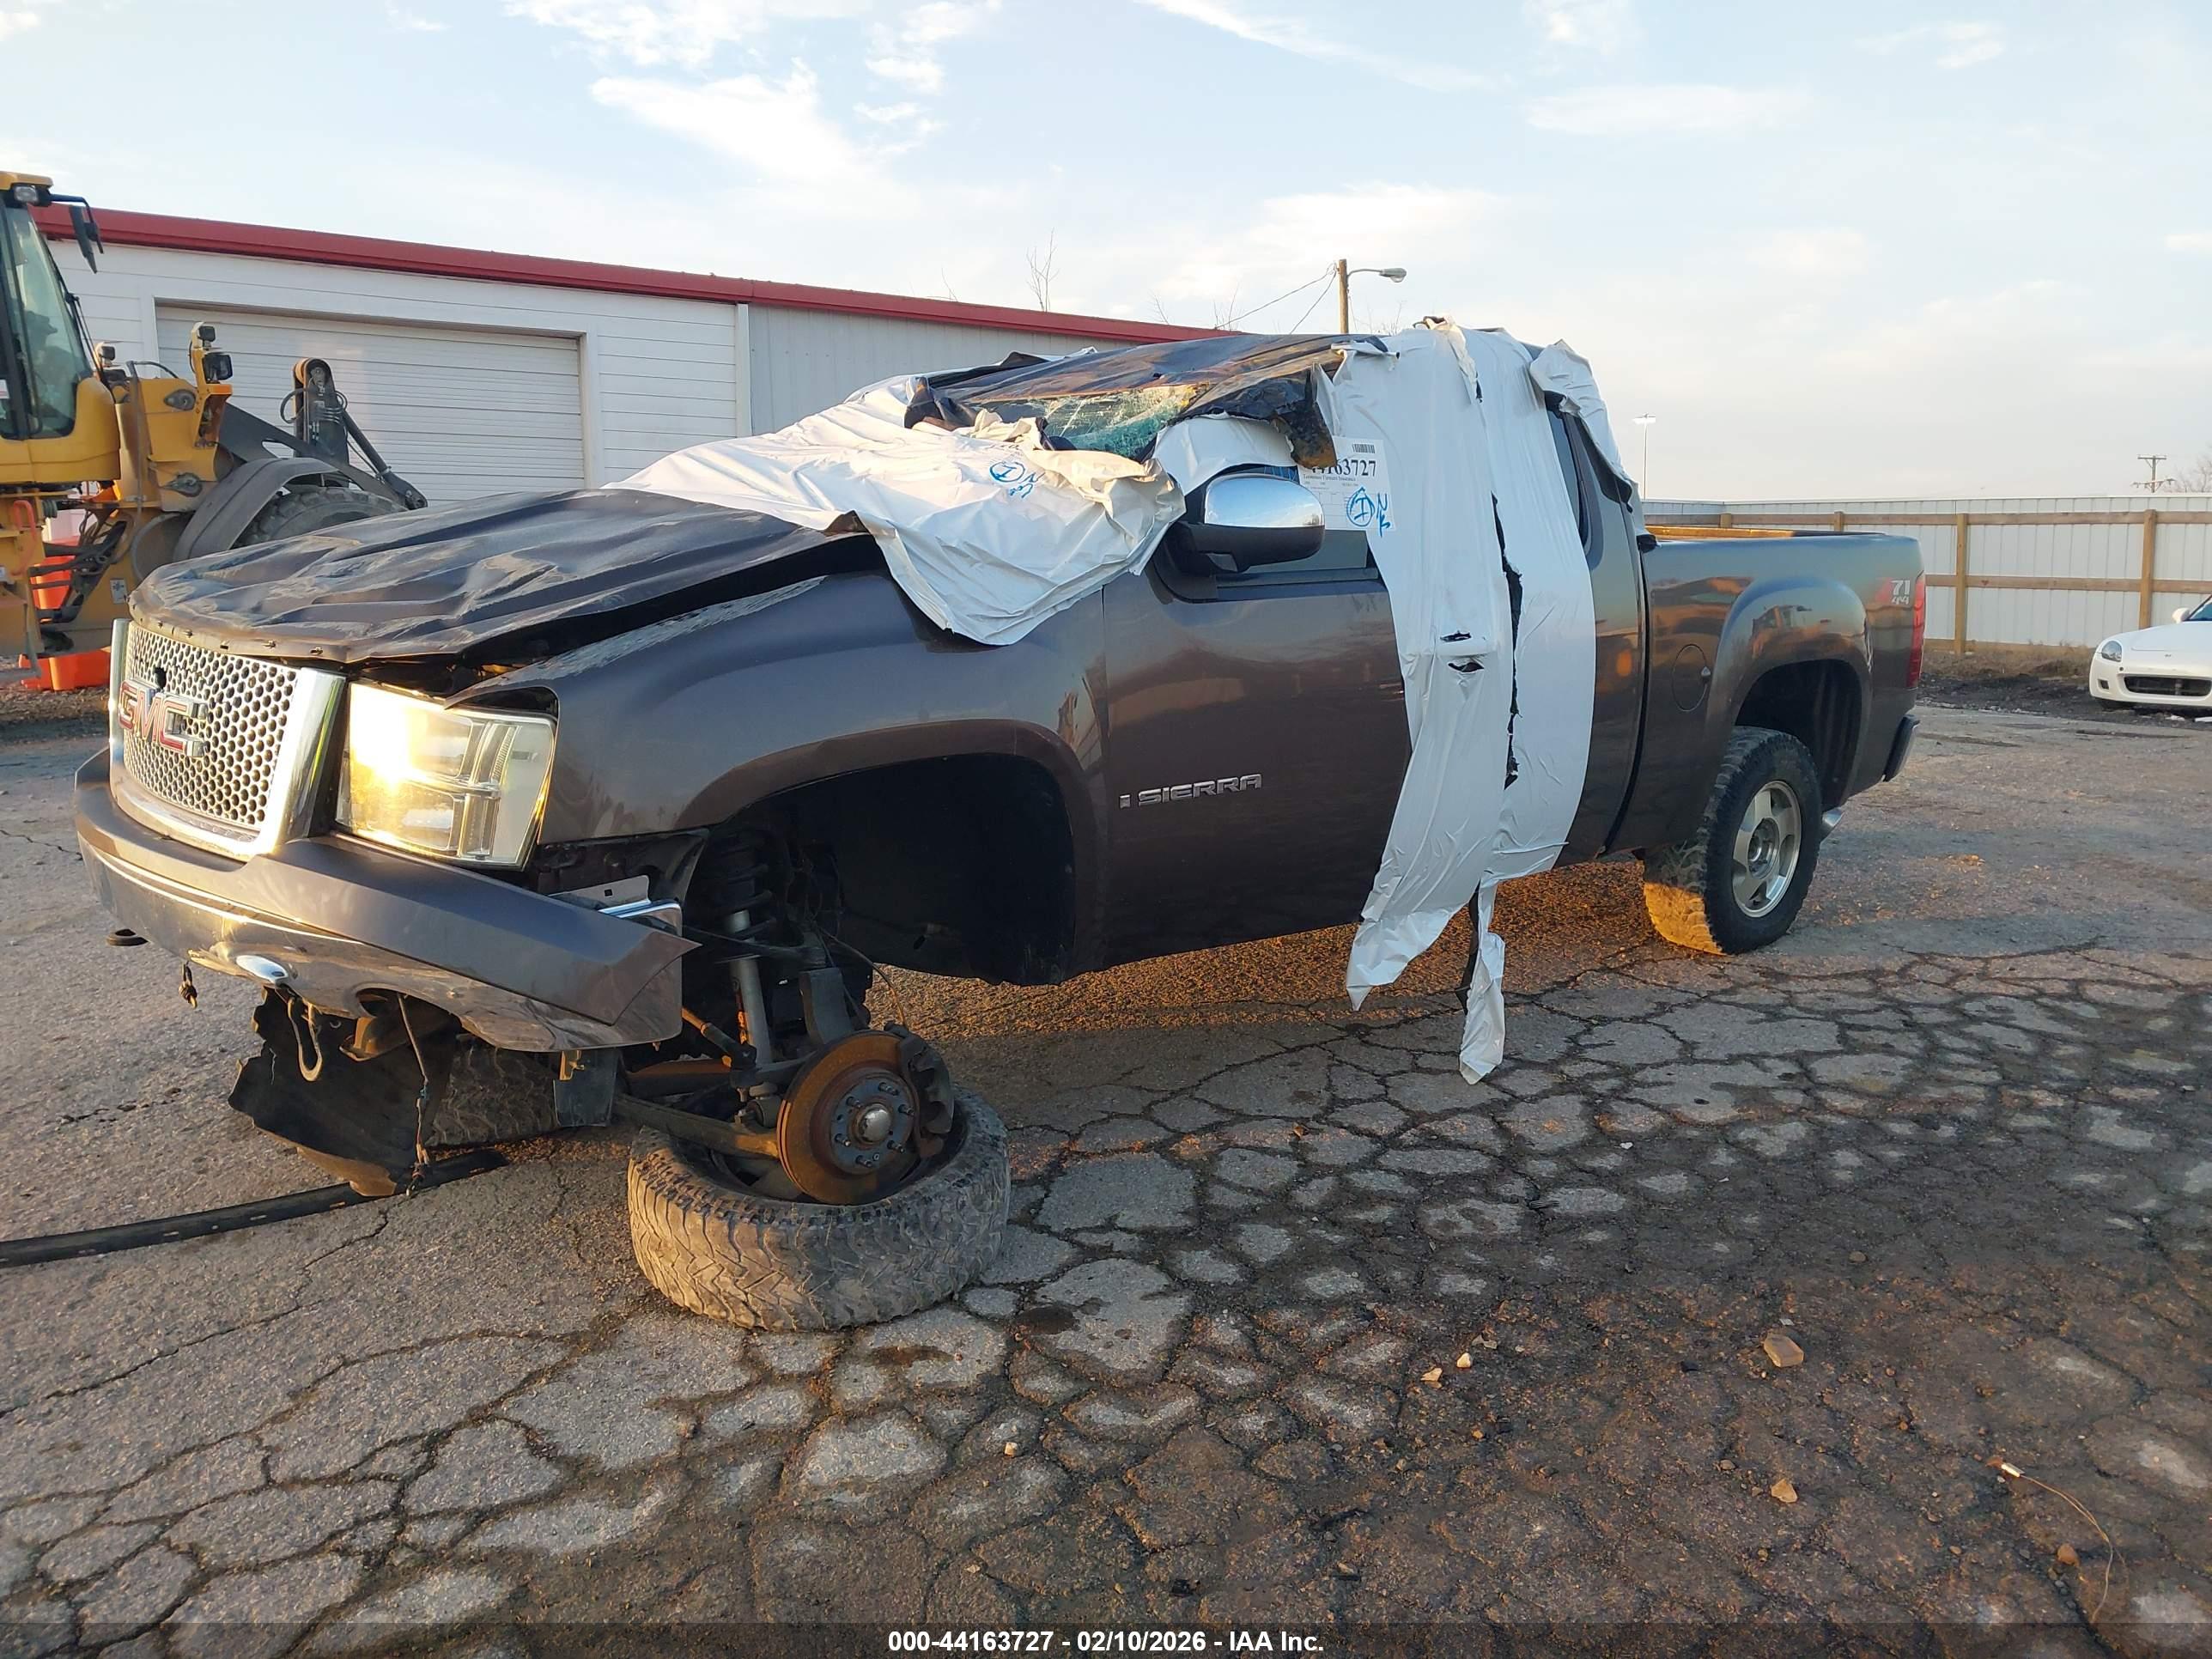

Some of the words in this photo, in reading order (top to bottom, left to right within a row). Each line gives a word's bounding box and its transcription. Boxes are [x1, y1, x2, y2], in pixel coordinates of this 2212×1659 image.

[1312, 459, 1376, 476] 63727
[118, 679, 204, 757] GMC
[1138, 773, 1263, 807] SIERRA
